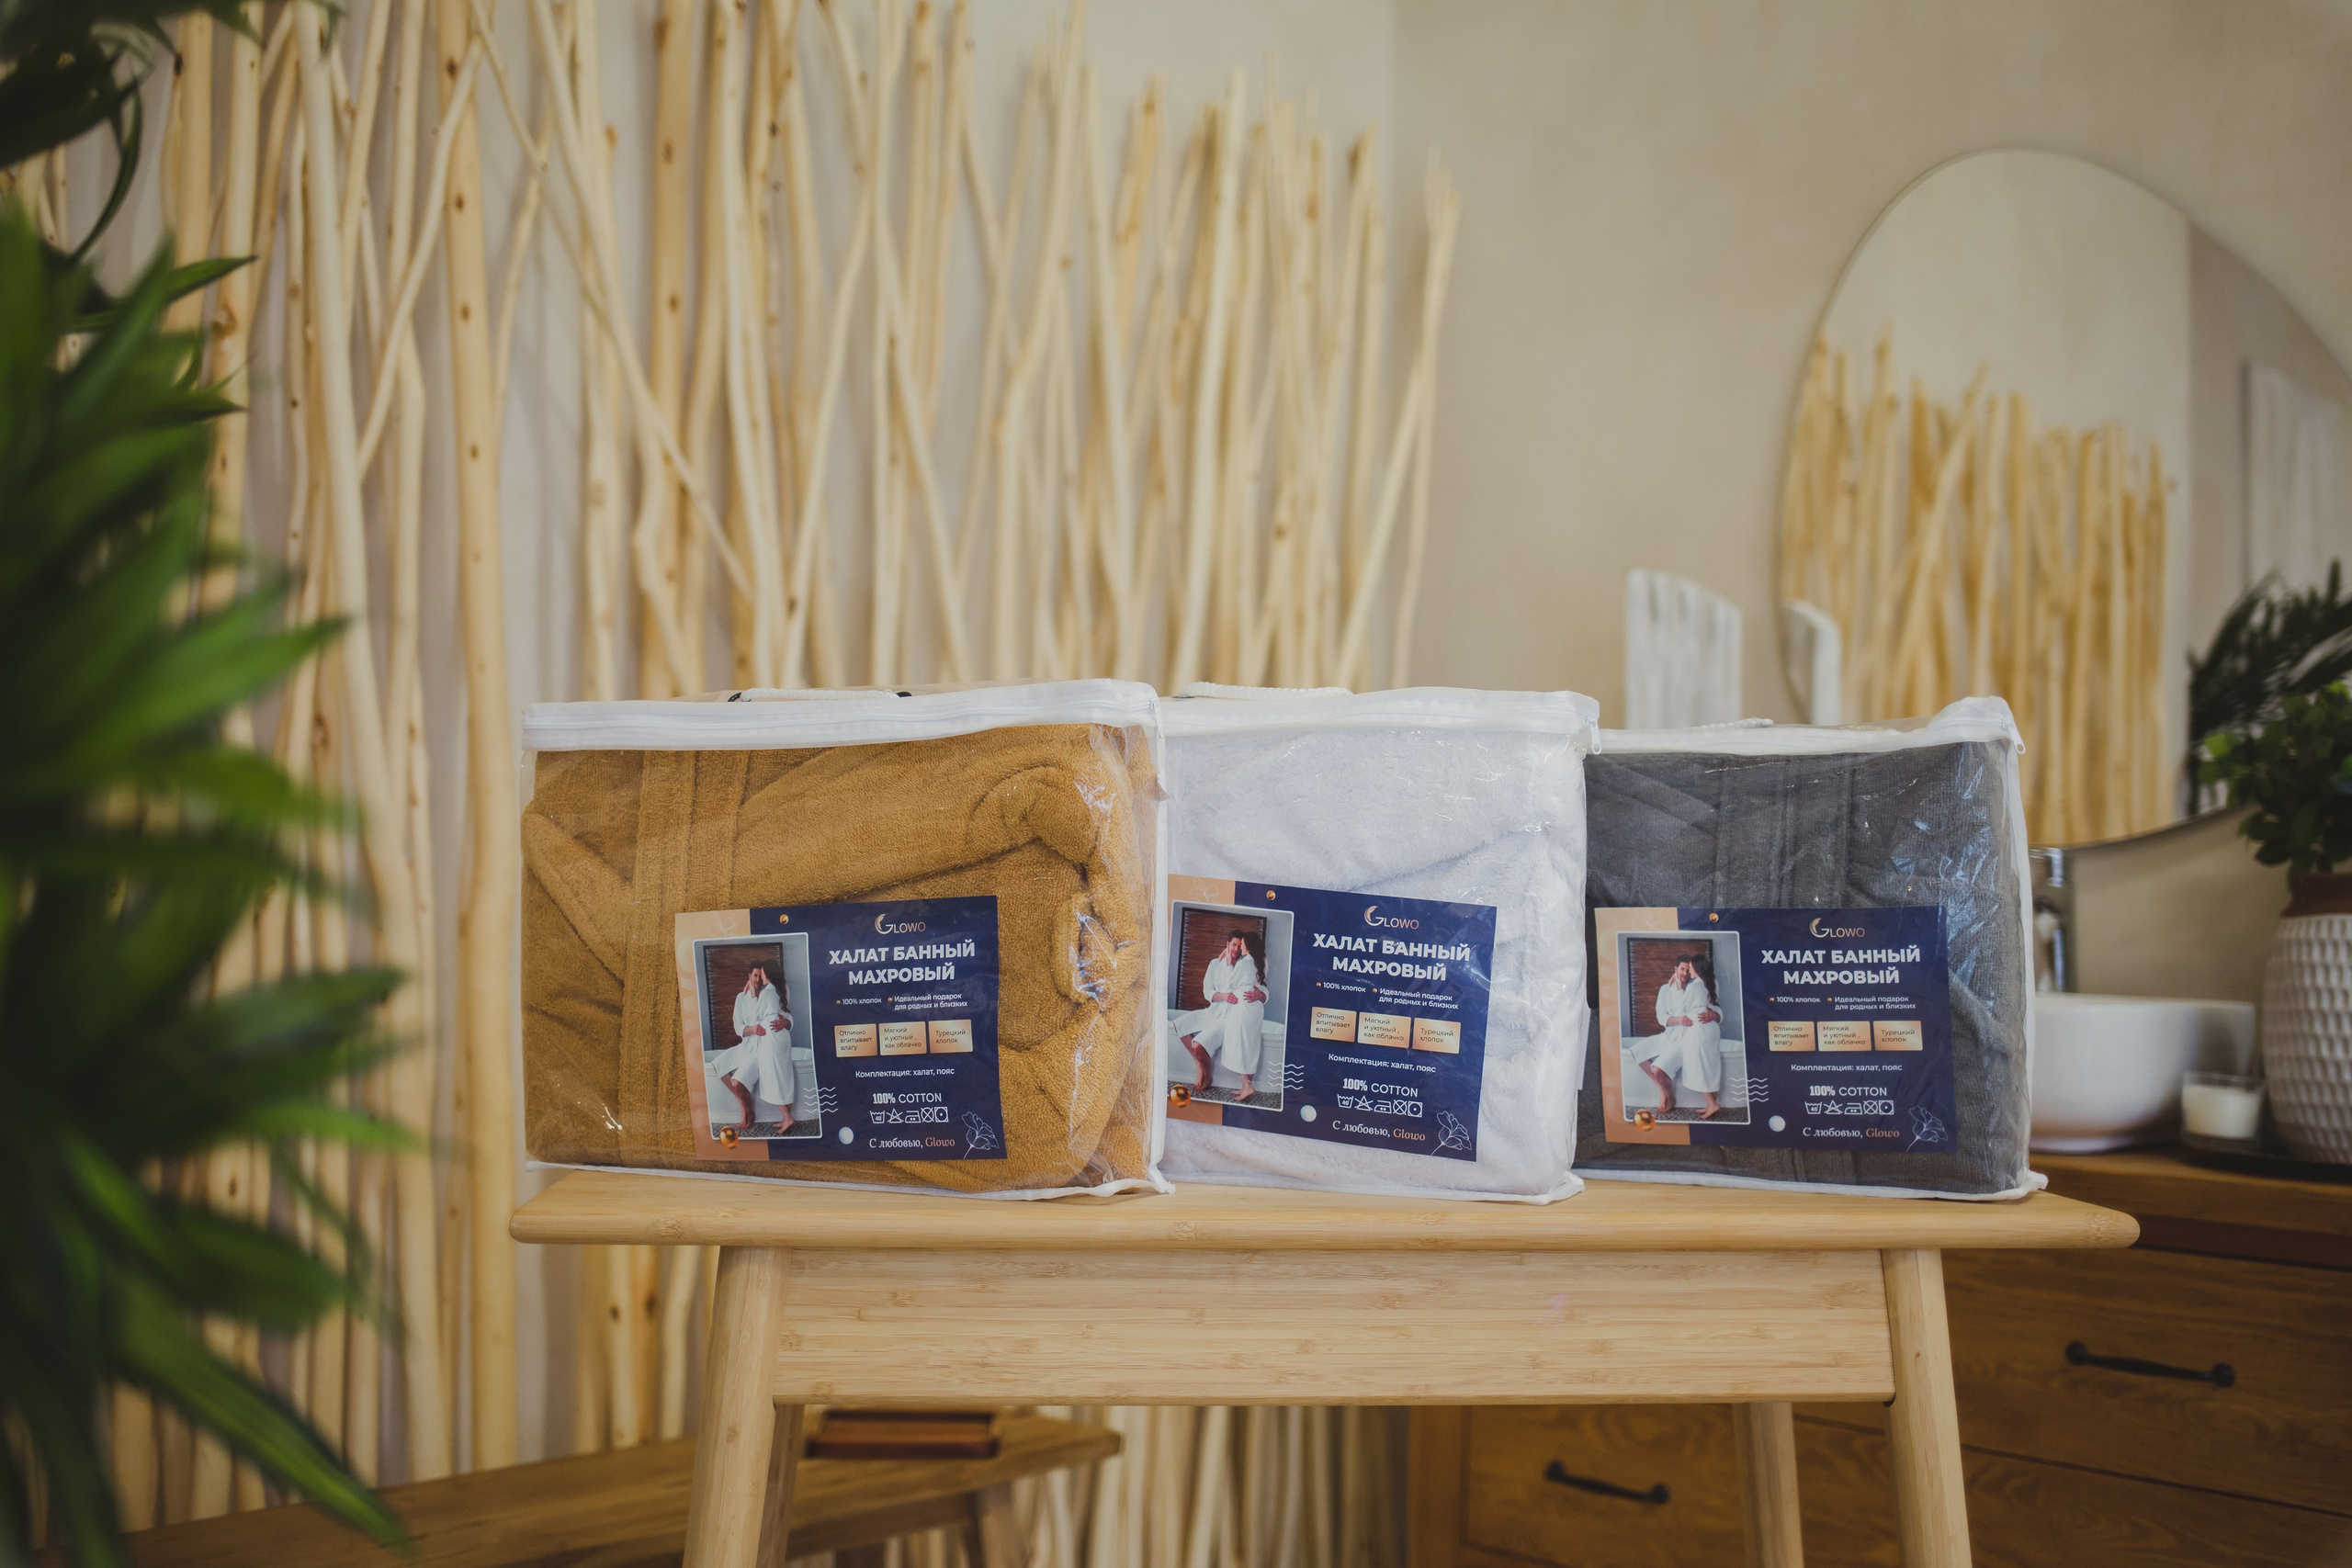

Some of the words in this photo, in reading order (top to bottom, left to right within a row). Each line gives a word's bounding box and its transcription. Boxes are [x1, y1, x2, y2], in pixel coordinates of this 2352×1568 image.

[829, 948, 889, 964] ХАЛАТ
[893, 939, 976, 961] БАННЫЙ
[1313, 933, 1377, 953] ХАЛАТ
[1383, 941, 1471, 961] БАННЫЙ
[1761, 950, 1826, 964] ХАЛАТ
[1831, 944, 1920, 964] БАННЫЙ
[849, 962, 955, 985] МАХРОВЫЙ
[1332, 956, 1447, 981] МАХРОВЫЙ
[1784, 966, 1900, 984] МАХРОВЫЙ
[895, 994, 932, 1002] Идеальный
[1380, 988, 1420, 998] Идеальный
[1422, 993, 1453, 1001] подарок
[1429, 1000, 1458, 1010] близких
[1316, 1020, 1351, 1028] впитывает
[1364, 1017, 1390, 1025] Мягкий
[1376, 1032, 1404, 1041] облачко
[1420, 1028, 1453, 1037] Турецкий
[1329, 1054, 1389, 1067] Комплектация:
[1391, 1061, 1415, 1071] халат,
[1416, 1065, 1436, 1073] пояс
[1343, 1078, 1368, 1091] 100%
[1372, 1083, 1419, 1097] COTTON
[1810, 1086, 1836, 1096] 100%
[1838, 1087, 1887, 1096] COTTON
[873, 1093, 896, 1104] 100%
[899, 1093, 942, 1103] COTTON
[1332, 1121, 1340, 1130] С
[1342, 1123, 1390, 1137] любовью,
[1394, 1129, 1426, 1141] Glowo
[1803, 1127, 1811, 1136] С
[1814, 1127, 1863, 1138] любовью,
[1865, 1128, 1900, 1137] Glowo
[869, 1138, 876, 1148] С
[879, 1138, 923, 1148] любовью,
[925, 1137, 956, 1147] Glowo
